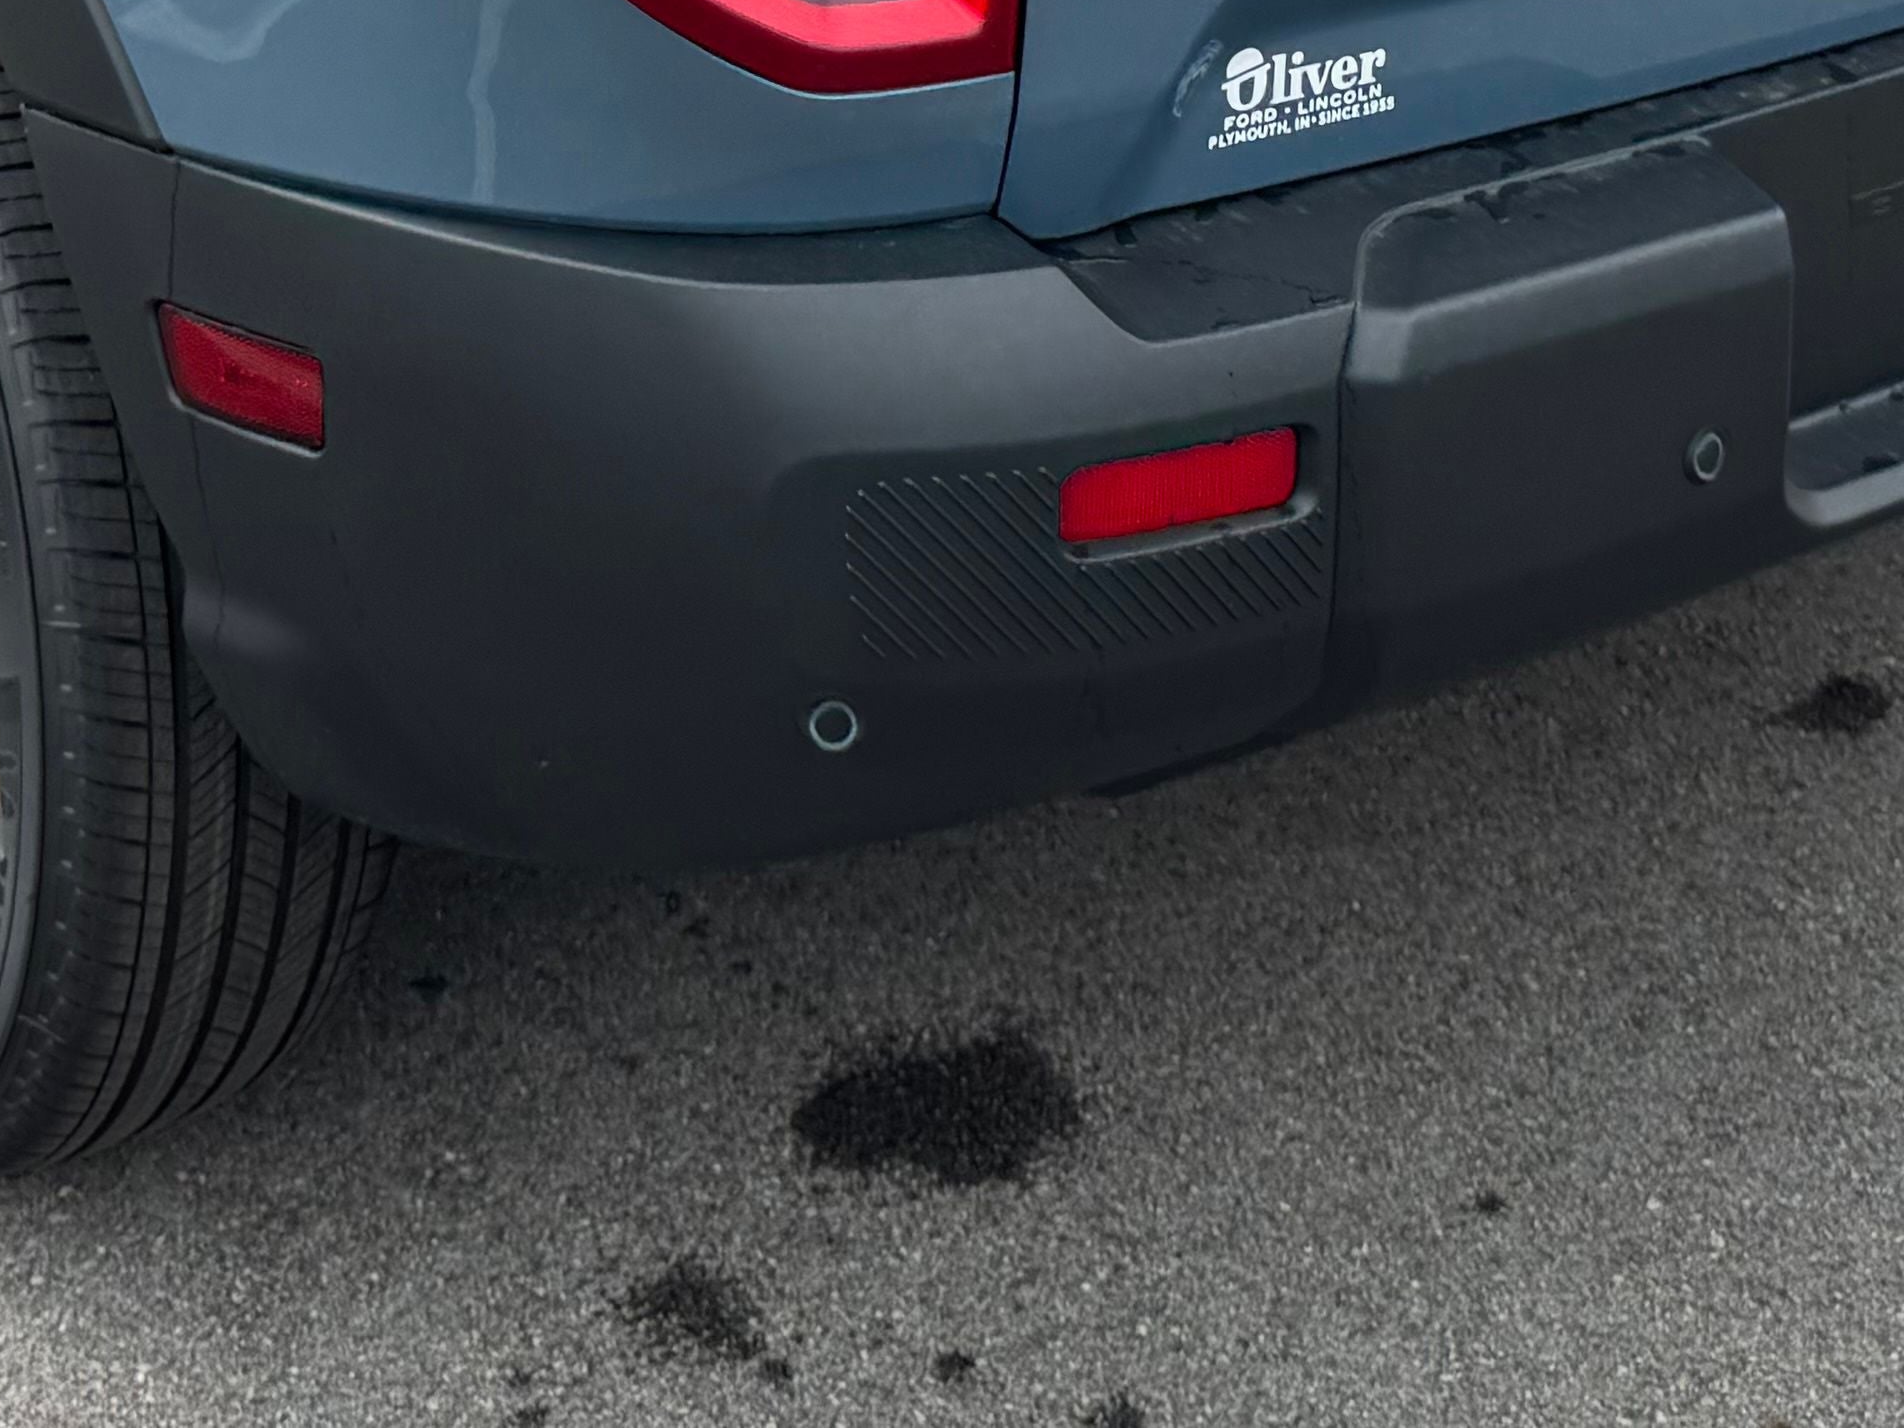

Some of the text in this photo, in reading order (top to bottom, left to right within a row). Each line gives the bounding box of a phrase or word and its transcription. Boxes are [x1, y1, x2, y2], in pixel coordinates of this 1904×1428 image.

[1221, 47, 1387, 112] Oliver
[1223, 83, 1383, 131] FORD LINCOLN
